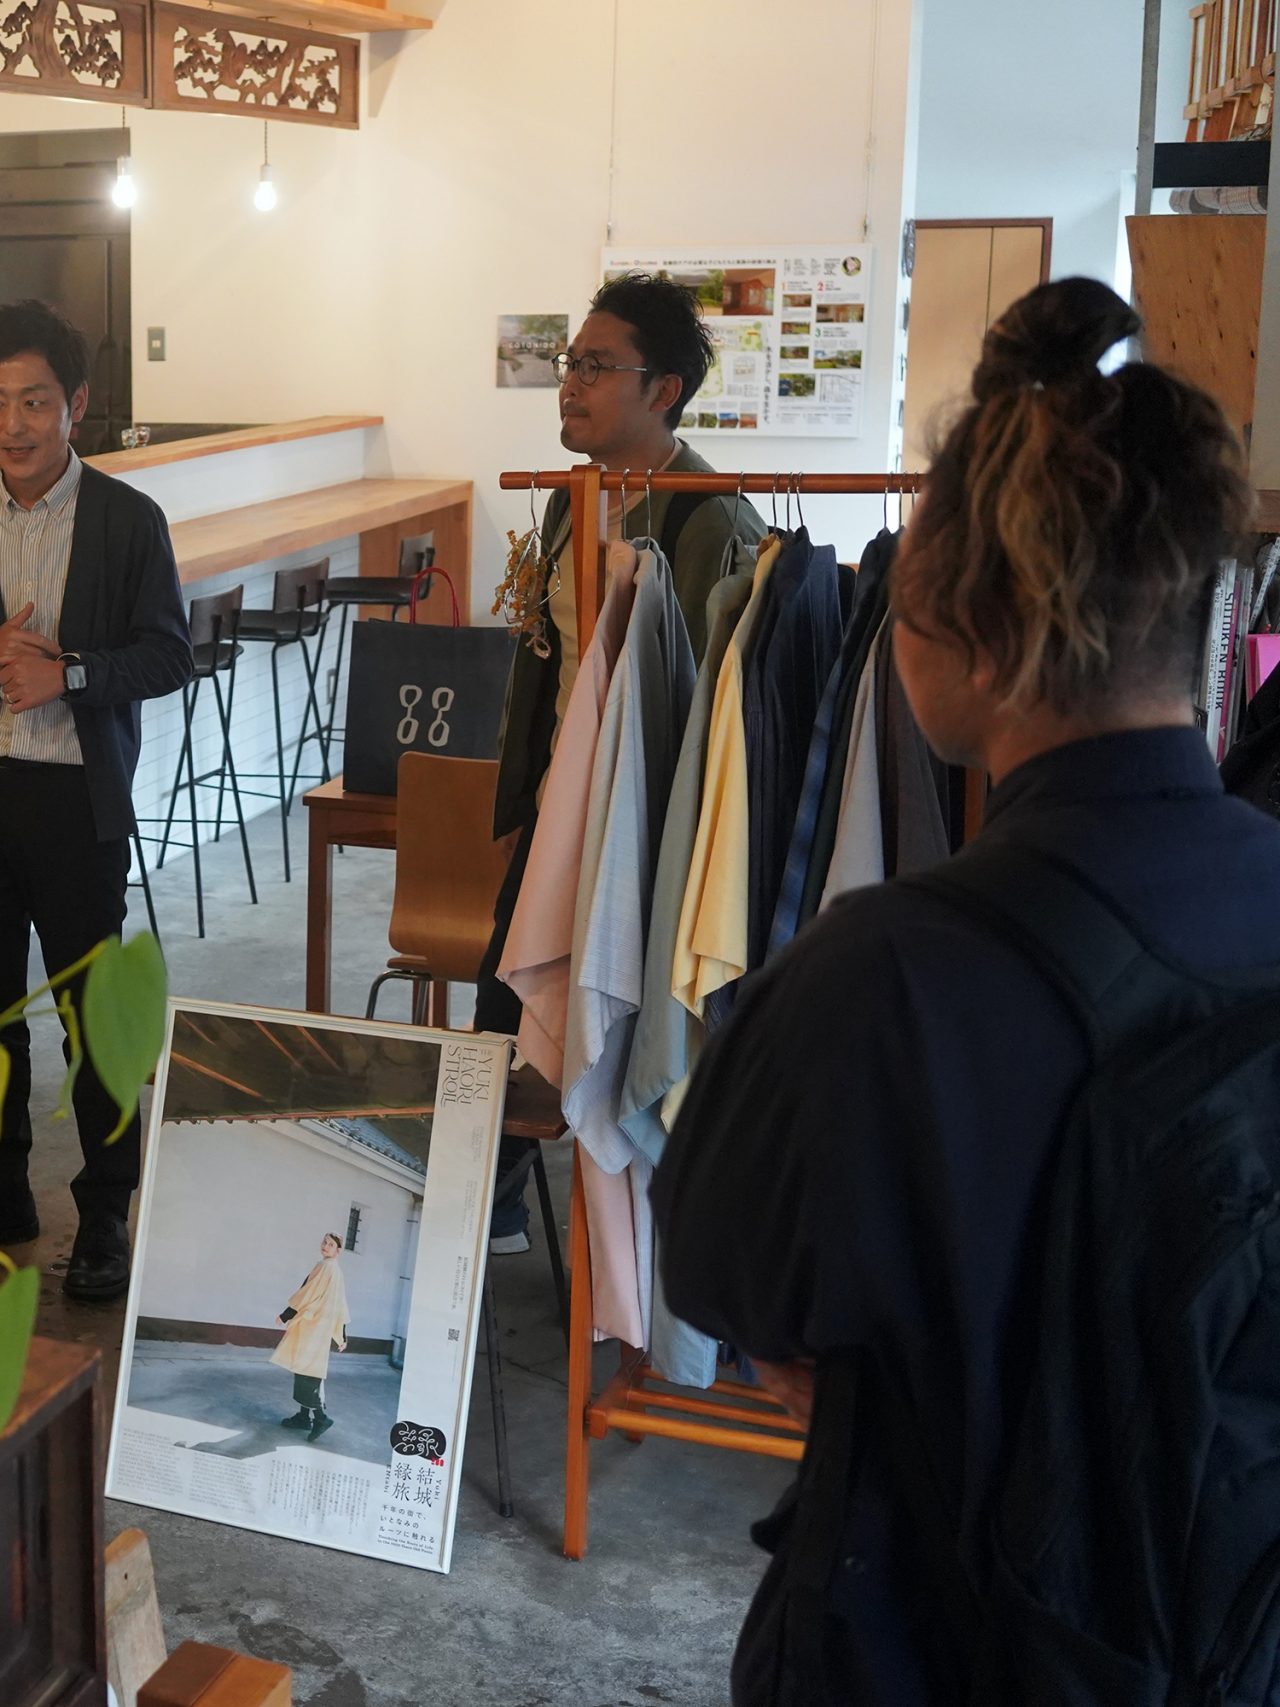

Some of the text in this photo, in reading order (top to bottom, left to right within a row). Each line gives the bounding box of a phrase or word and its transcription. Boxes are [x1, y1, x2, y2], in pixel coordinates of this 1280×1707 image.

[440, 1044, 462, 1108] STROLL
[457, 1047, 478, 1105] HAORI
[473, 1057, 494, 1100] YUKI
[391, 1462, 412, 1501] 縁旅
[413, 1467, 435, 1507] 結城
[380, 1515, 419, 1529] いとなみの
[380, 1526, 435, 1543] ルーツに触れる
